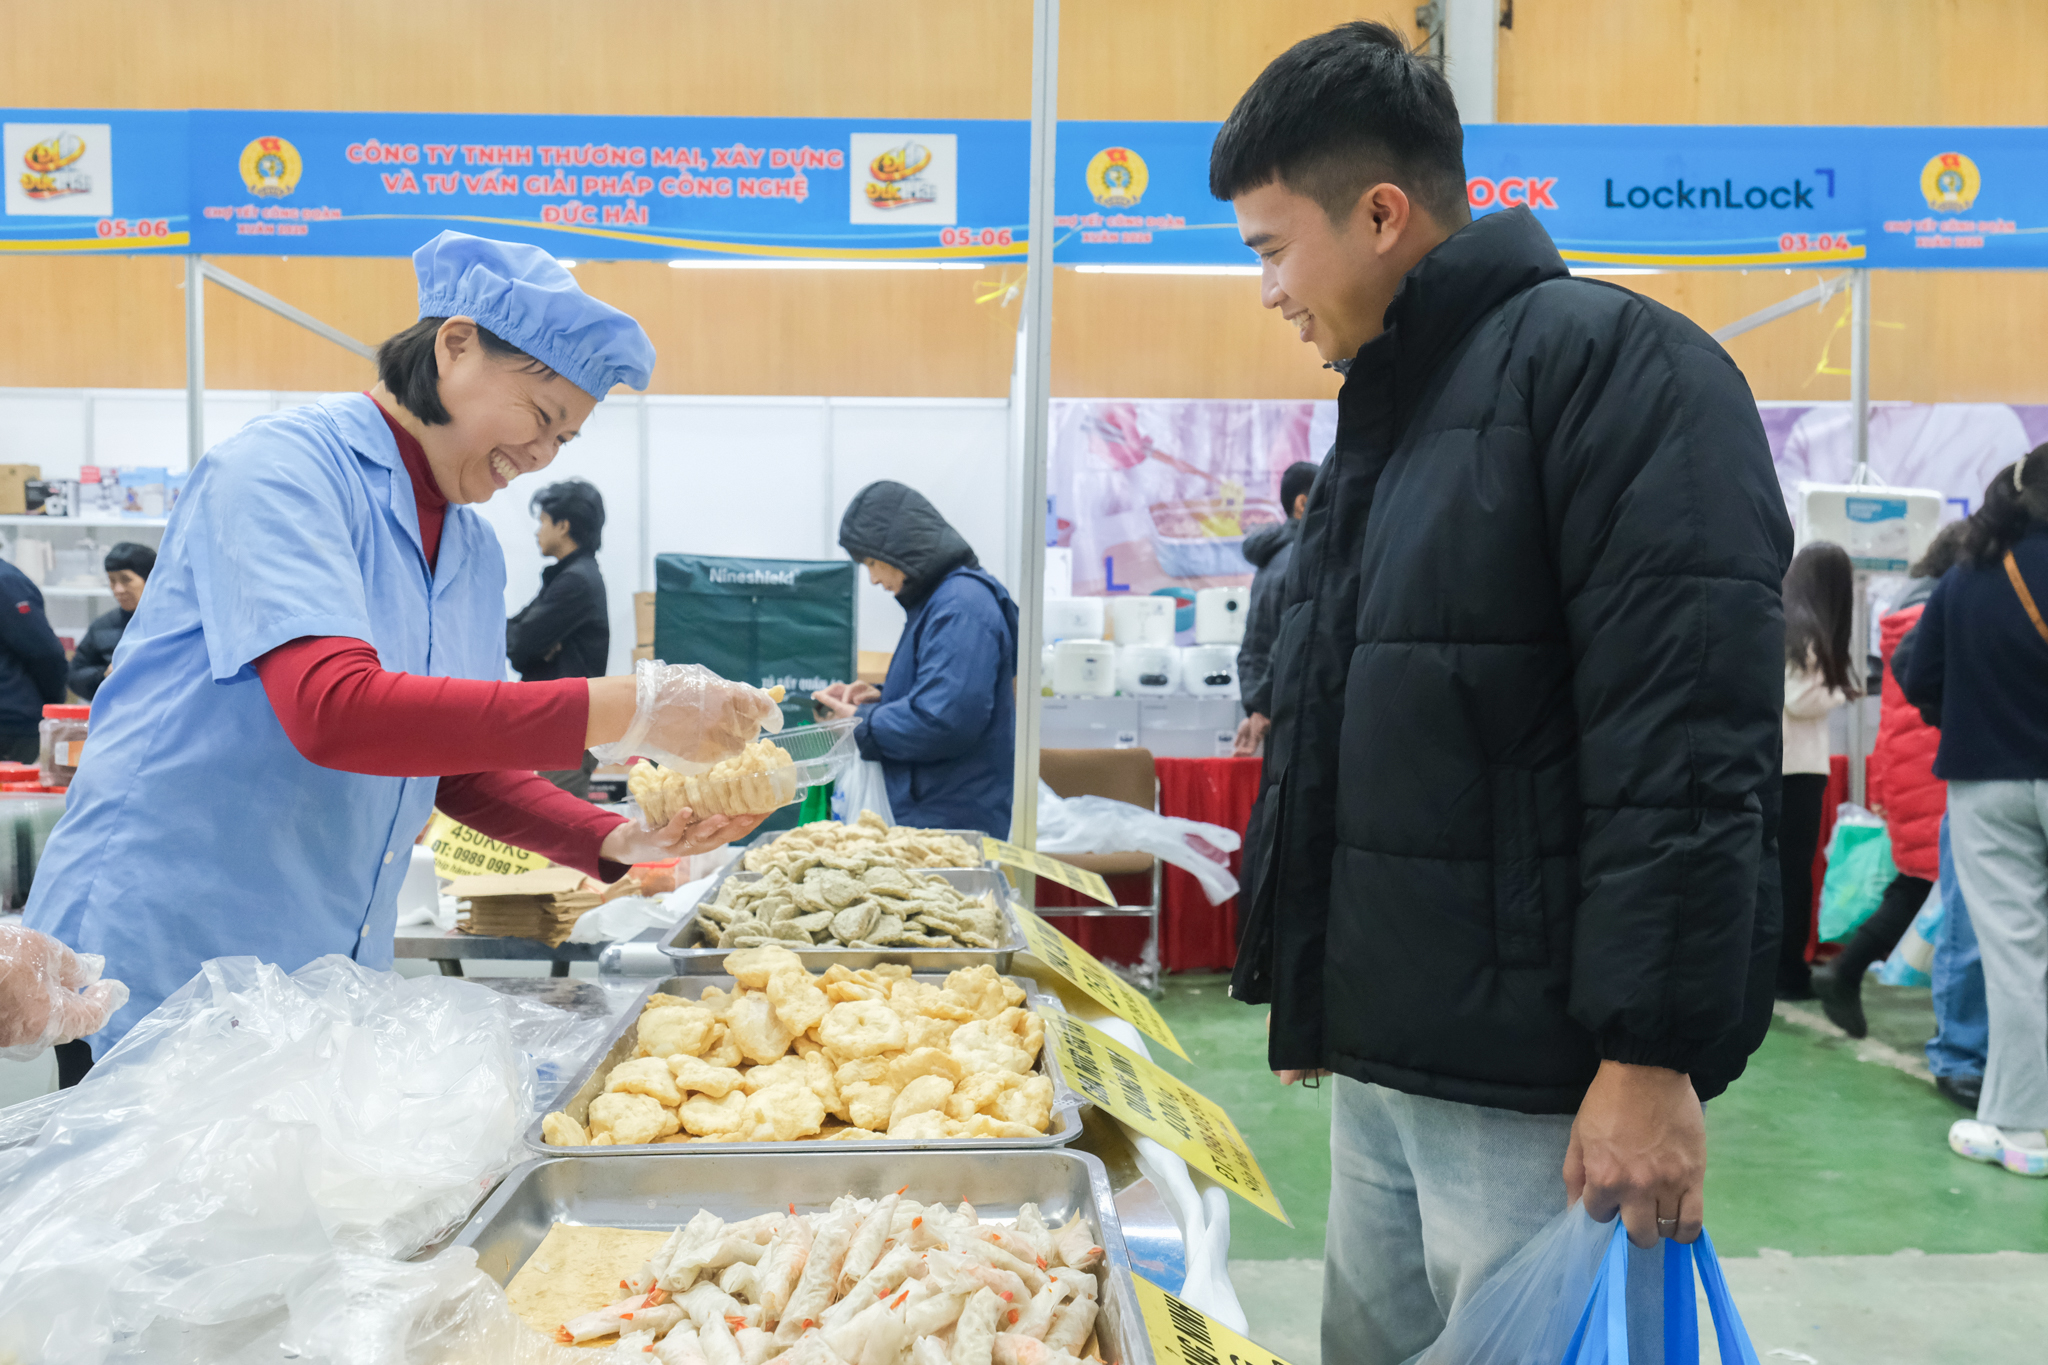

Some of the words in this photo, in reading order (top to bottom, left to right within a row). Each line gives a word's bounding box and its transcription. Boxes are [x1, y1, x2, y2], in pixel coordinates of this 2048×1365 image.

[346, 138, 419, 164] CÔNG
[423, 145, 458, 165] TY
[460, 145, 533, 166] TNHH
[537, 143, 646, 166] THƯƠNG
[651, 147, 707, 172] MẠI,
[711, 143, 765, 169] XÂY
[769, 145, 844, 173] DỰNG
[381, 168, 420, 194] VÀ
[423, 171, 459, 194] TƯ
[462, 168, 518, 195] VẤN
[524, 169, 576, 196] GIẢI
[582, 171, 653, 197] PHÁP
[658, 171, 732, 197] CÔNG
[737, 173, 809, 203] NGHỆ
[1466, 176, 1559, 210] OCK
[1605, 178, 1814, 209] LocknLock
[540, 200, 597, 224] ĐỨC
[602, 199, 648, 225] HẢI
[96, 219, 170, 238] 05-06
[940, 228, 1013, 247] 05-06
[1778, 232, 1852, 252] 03-04
[709, 566, 795, 586] Nineshield
[453, 847, 486, 867] 0989
[1105, 1047, 1138, 1081] NINH
[1106, 1072, 1157, 1121] QUẢNG
[1164, 1293, 1215, 1352] NINH
